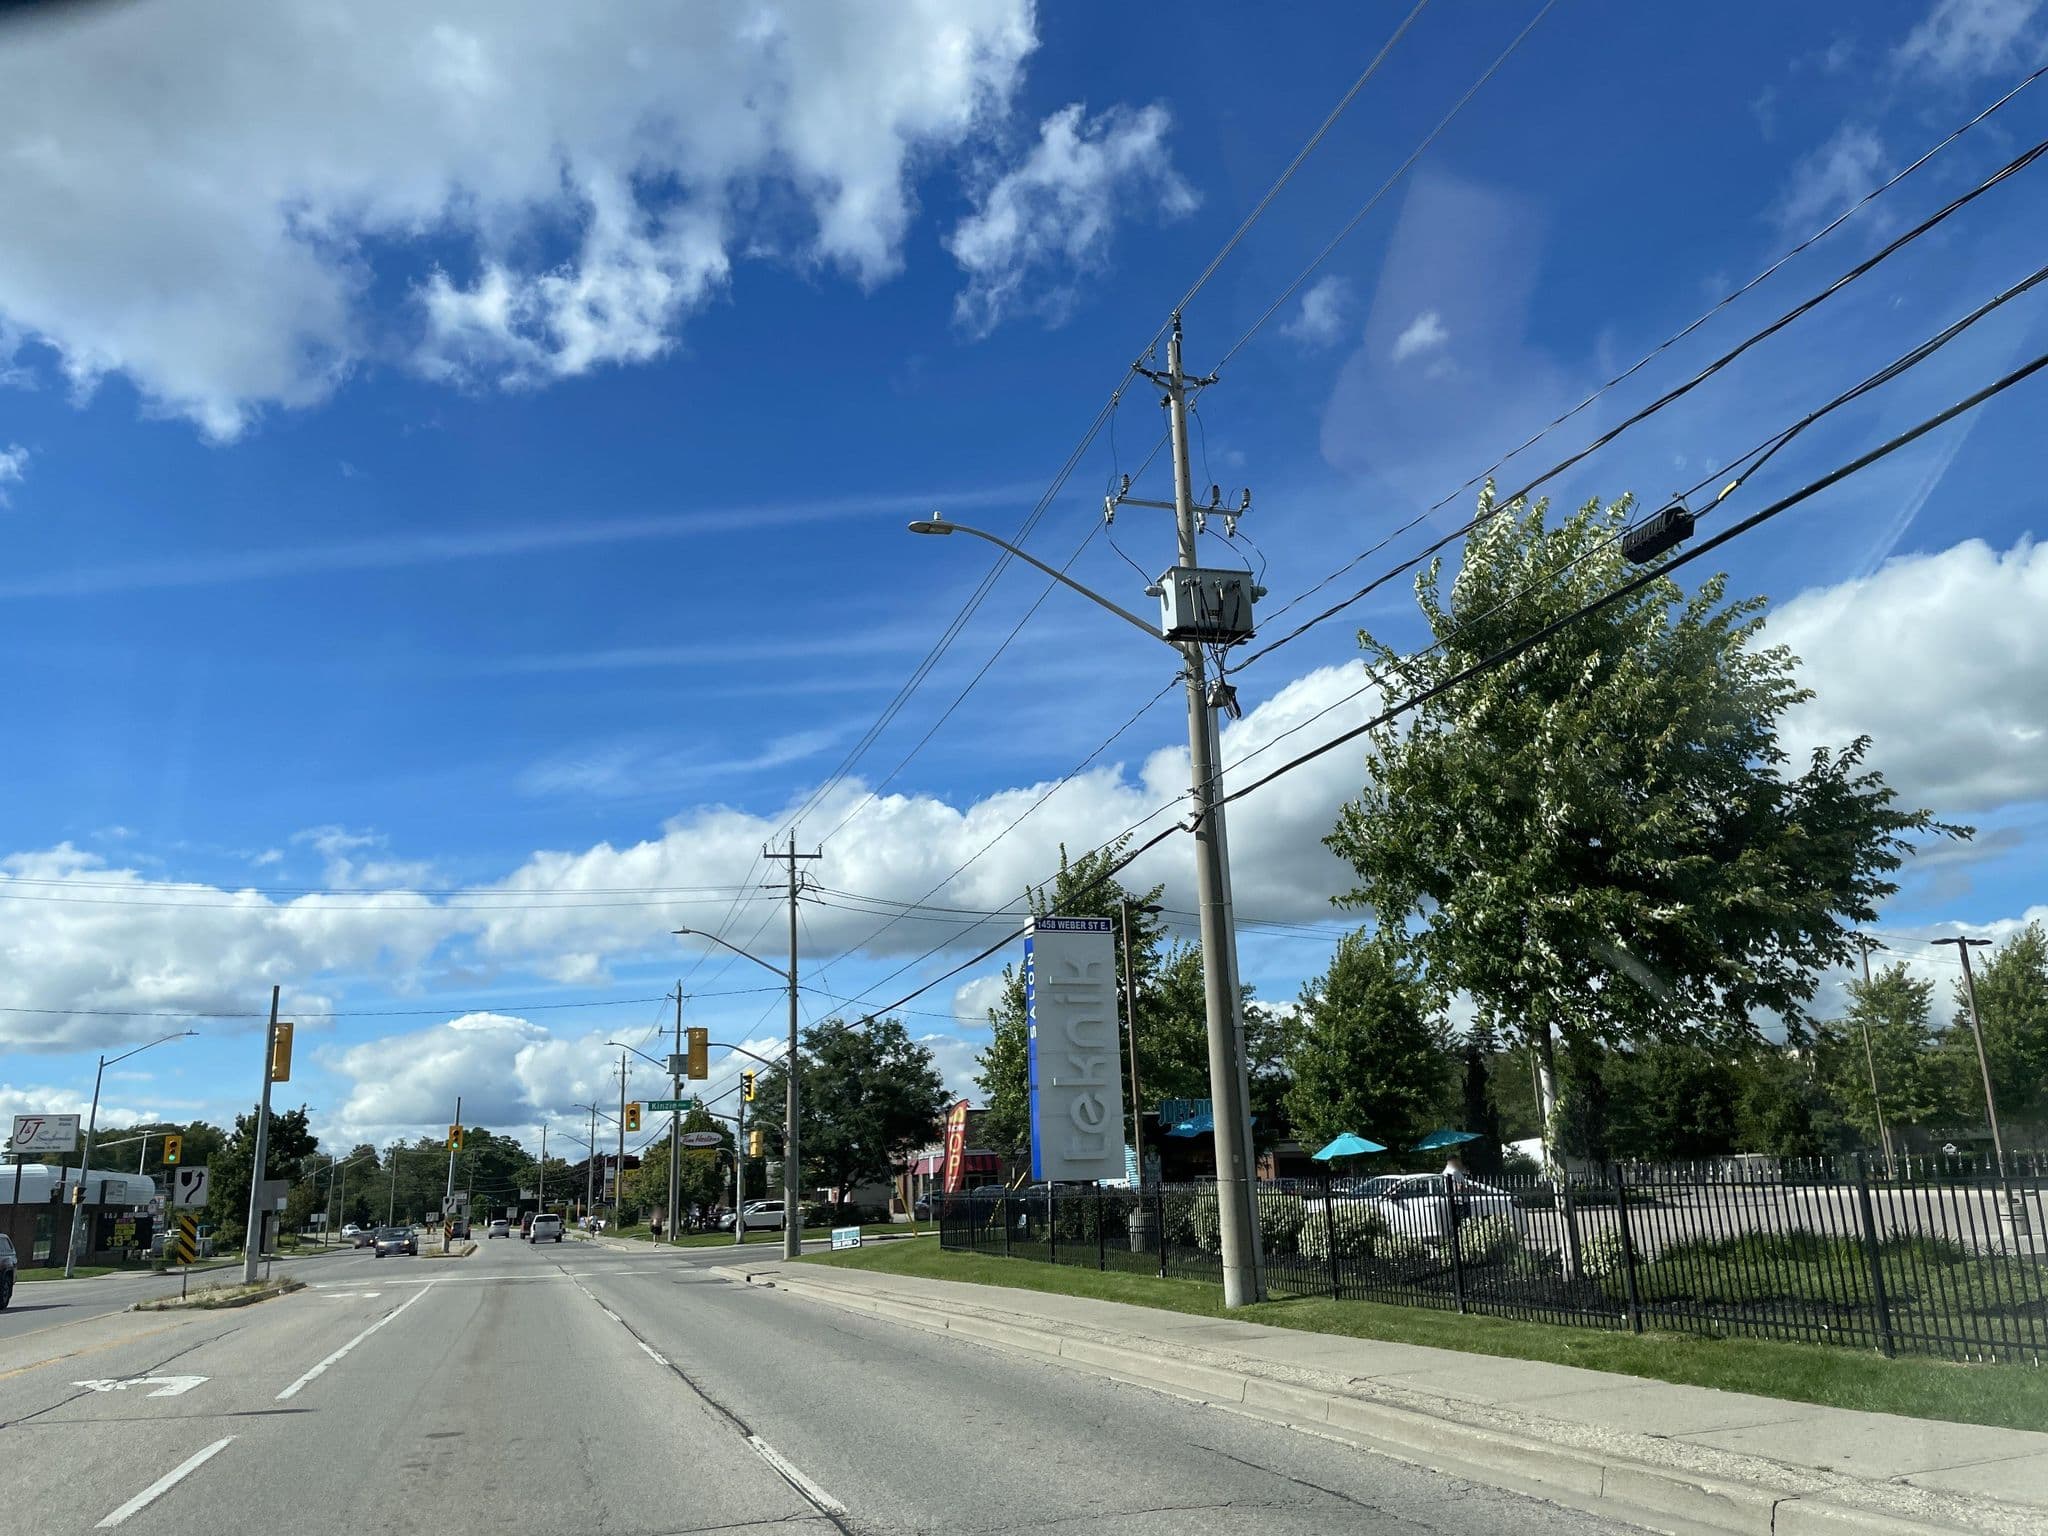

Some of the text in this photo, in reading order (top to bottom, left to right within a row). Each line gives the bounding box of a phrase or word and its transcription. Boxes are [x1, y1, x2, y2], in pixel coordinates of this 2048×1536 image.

[1057, 920, 1087, 930] WEBER
[1088, 921, 1099, 930] ST
[1100, 921, 1109, 930] E.
[1027, 952, 1037, 1039] SALON
[651, 1103, 677, 1111] Kinzie
